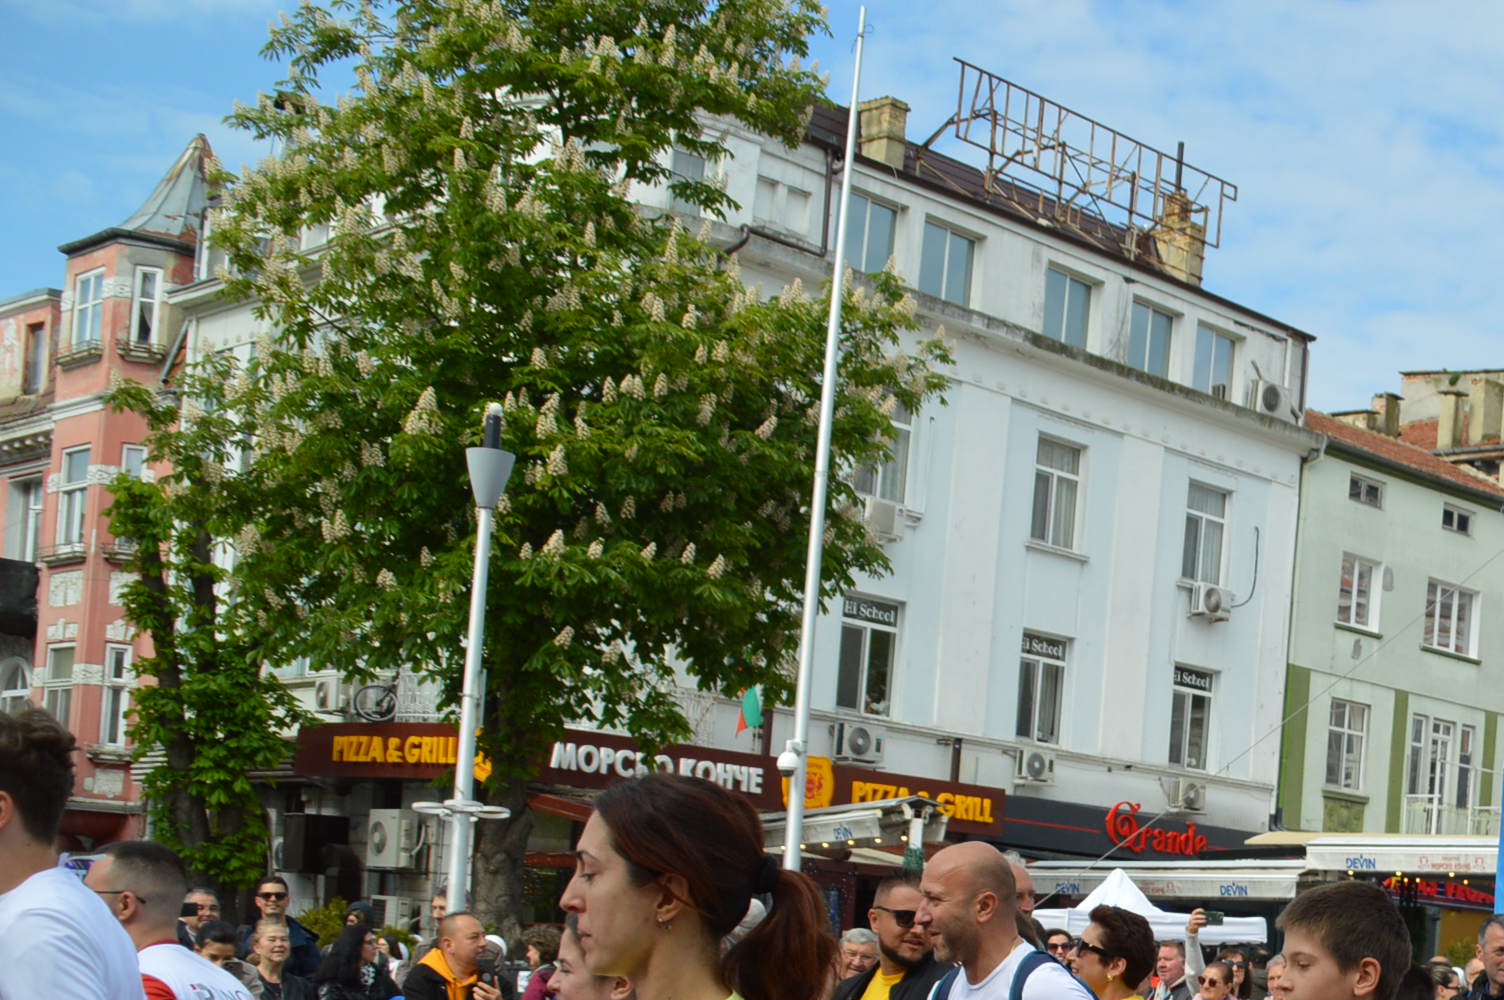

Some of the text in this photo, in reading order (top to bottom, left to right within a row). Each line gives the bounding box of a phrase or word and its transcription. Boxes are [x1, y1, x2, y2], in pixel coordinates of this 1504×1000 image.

[859, 603, 896, 624] School
[679, 758, 764, 794] КОНЧЕ
[935, 792, 994, 823] GRILL
[1105, 801, 1208, 856] Grande
[1346, 853, 1376, 869] DEVIN
[1219, 882, 1248, 897] DEVIN
